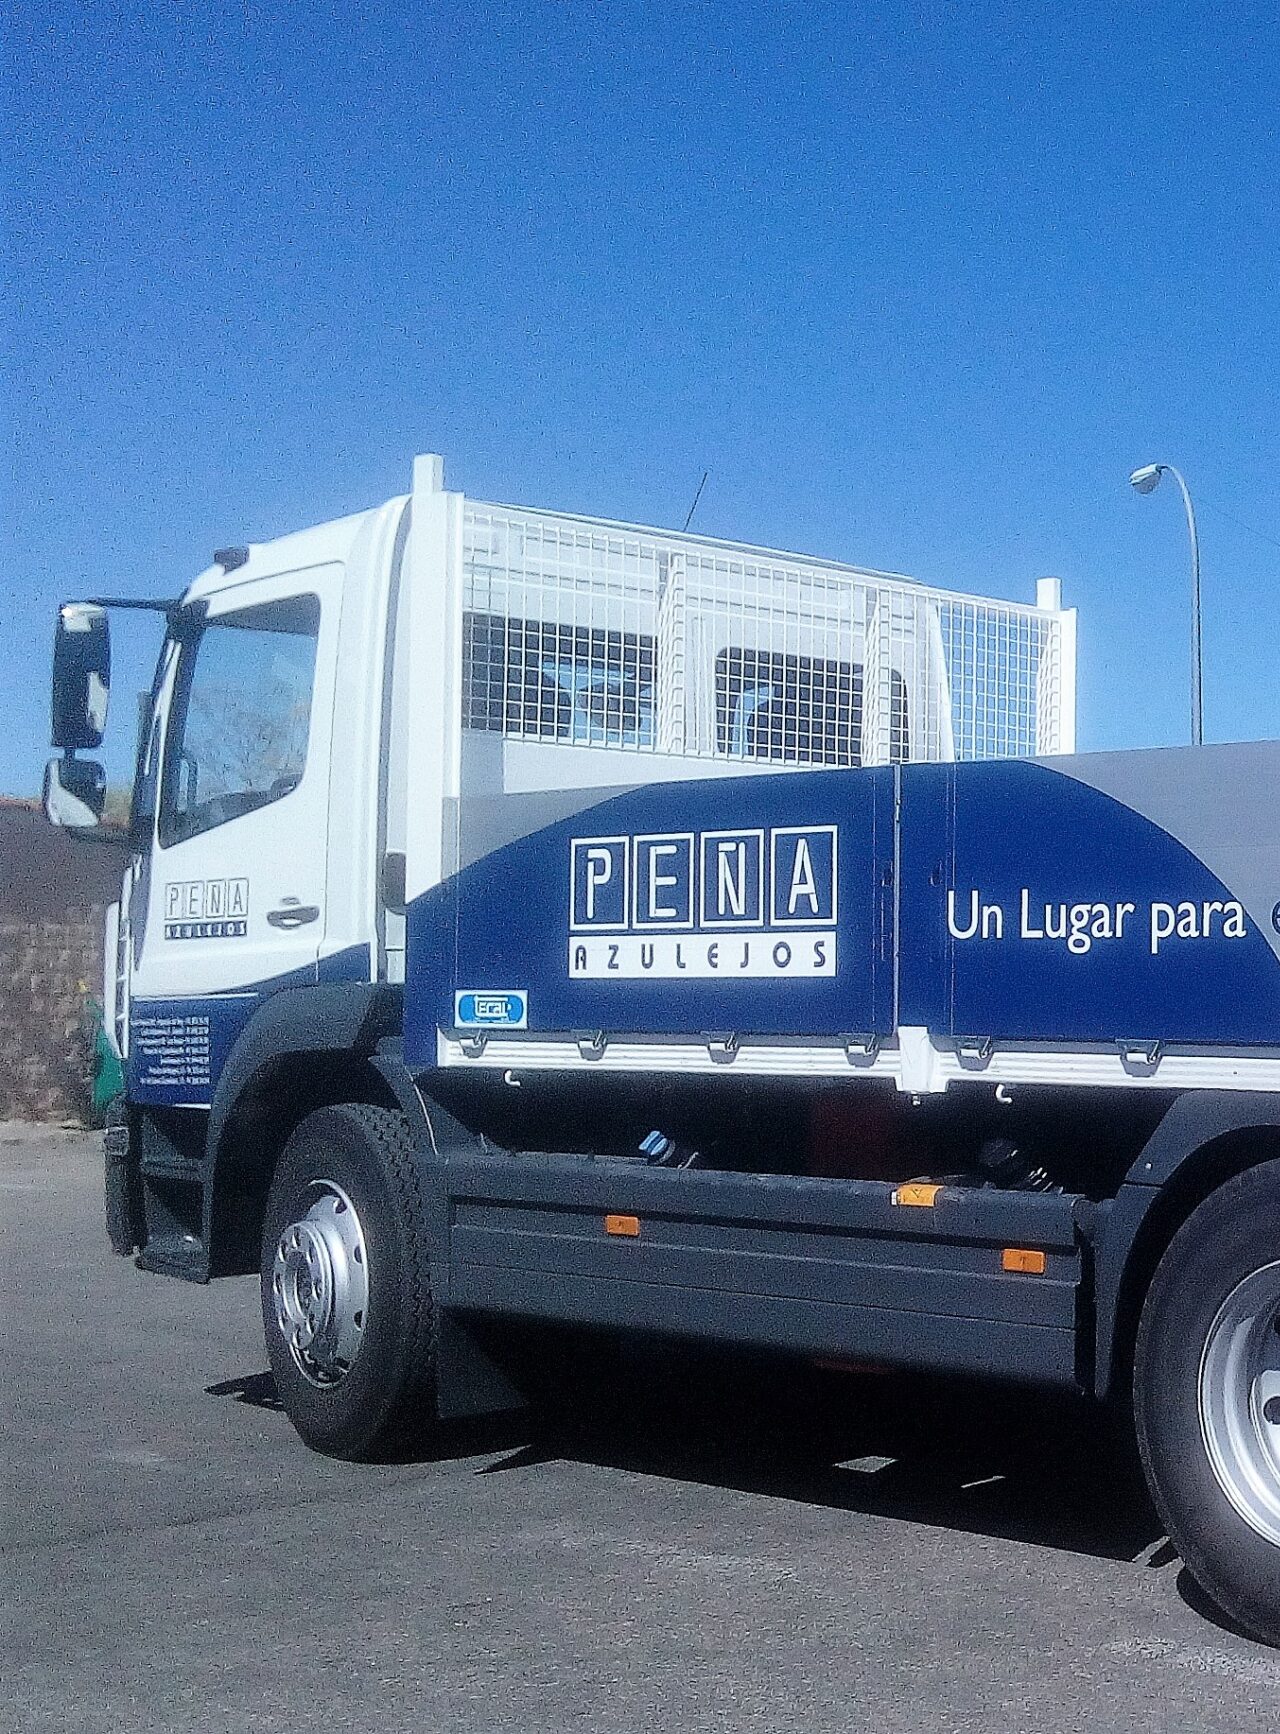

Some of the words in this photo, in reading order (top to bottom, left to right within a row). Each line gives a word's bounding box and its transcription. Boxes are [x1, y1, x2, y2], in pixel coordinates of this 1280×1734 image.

[587, 838, 819, 919] PEÑA
[948, 889, 1003, 939] Un
[1021, 888, 1135, 954] Lugar
[1151, 900, 1247, 954] para
[575, 941, 826, 970] AZULEJOS
